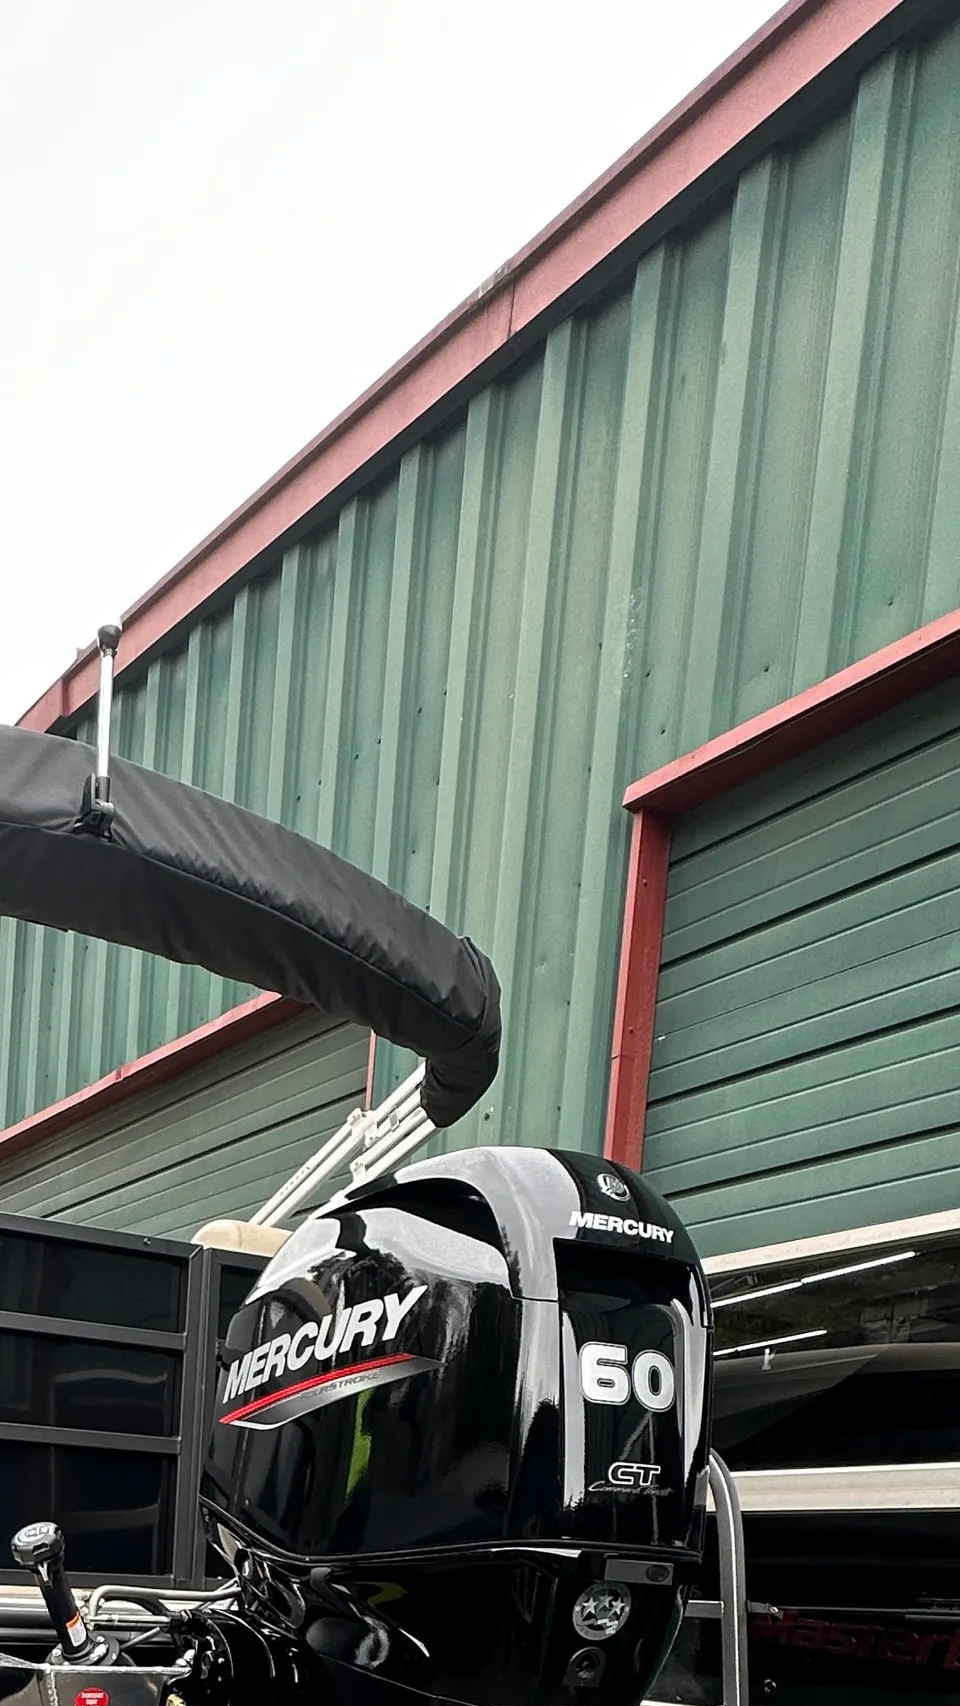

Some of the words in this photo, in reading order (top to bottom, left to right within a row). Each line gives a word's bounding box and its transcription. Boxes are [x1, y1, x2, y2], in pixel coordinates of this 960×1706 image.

[569, 1211, 674, 1243] MERCURY
[222, 1285, 428, 1404] MERCURY
[579, 1341, 675, 1413] 60
[607, 1462, 661, 1486] CT
